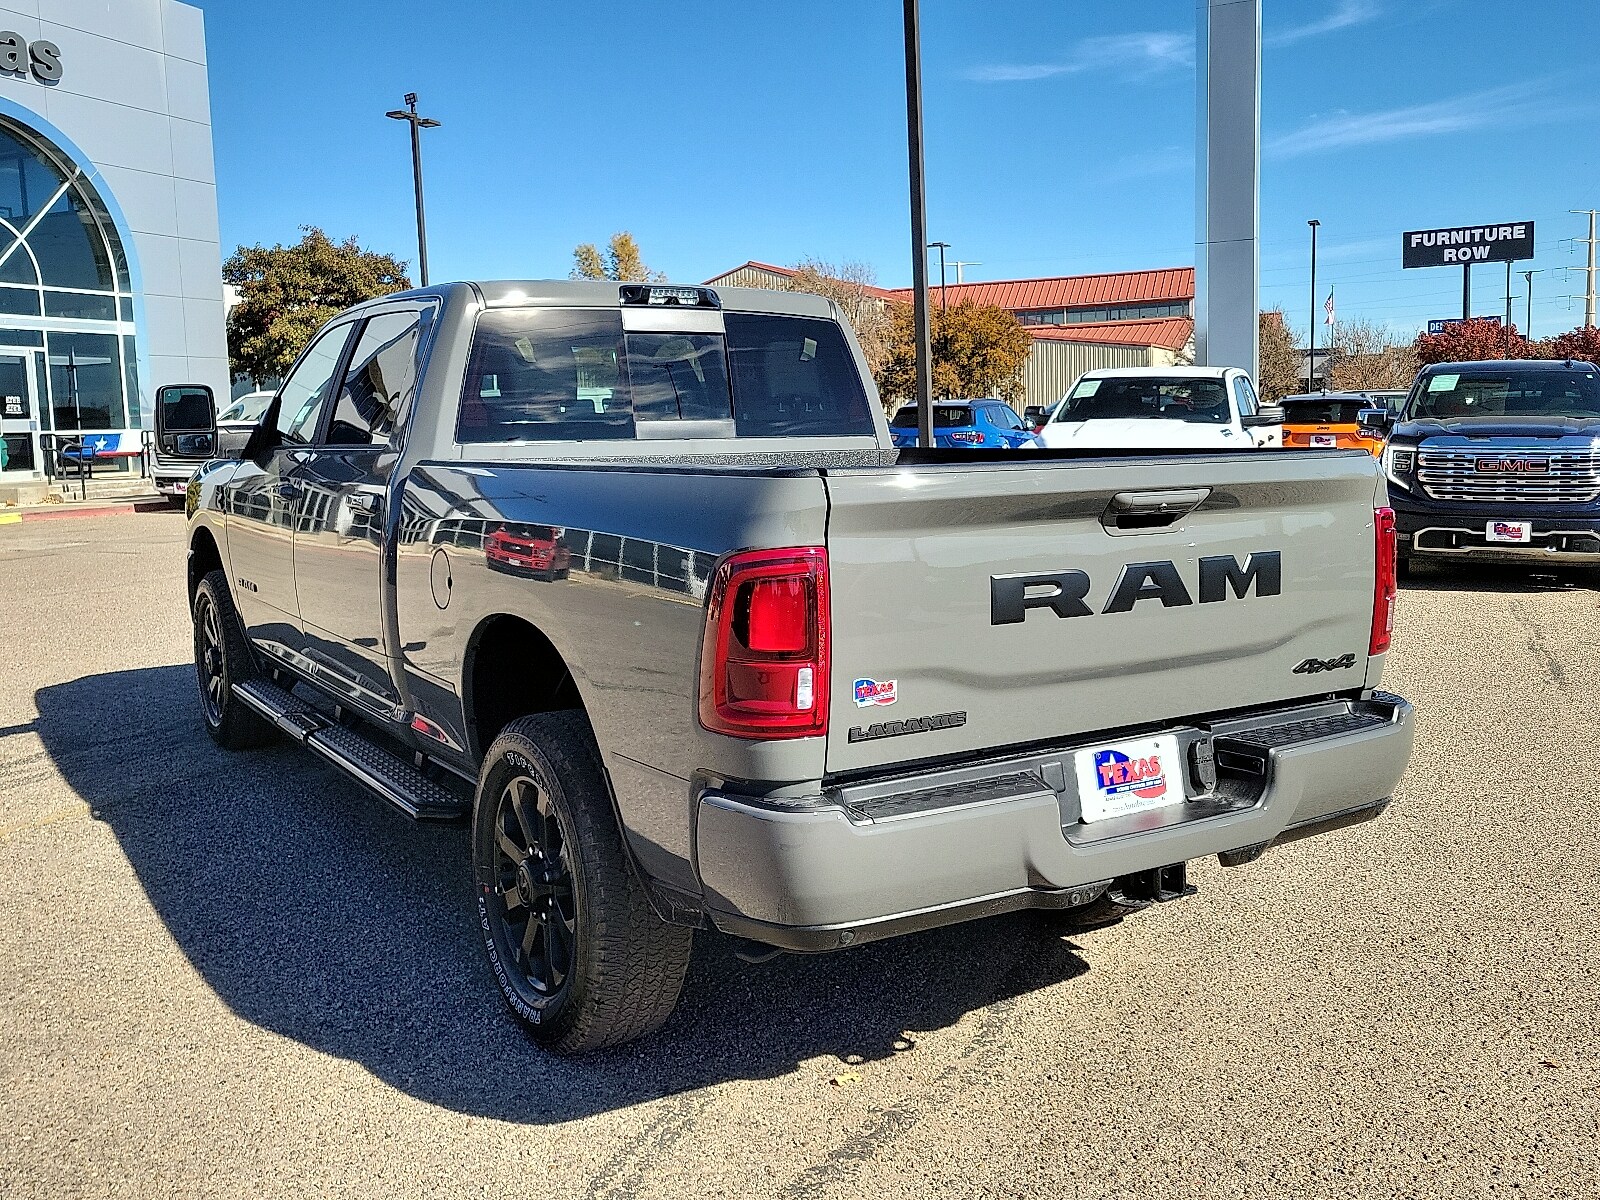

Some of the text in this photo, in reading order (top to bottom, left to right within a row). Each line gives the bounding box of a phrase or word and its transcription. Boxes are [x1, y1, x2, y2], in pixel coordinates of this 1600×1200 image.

[1411, 225, 1526, 247] FURNITURE
[1444, 246, 1490, 262] ROW
[1478, 459, 1547, 471] GMC
[990, 551, 1281, 625] RAM
[856, 682, 894, 699] TEXAS
[847, 711, 967, 743] LARAMIE
[1099, 756, 1161, 786] TEXAS
